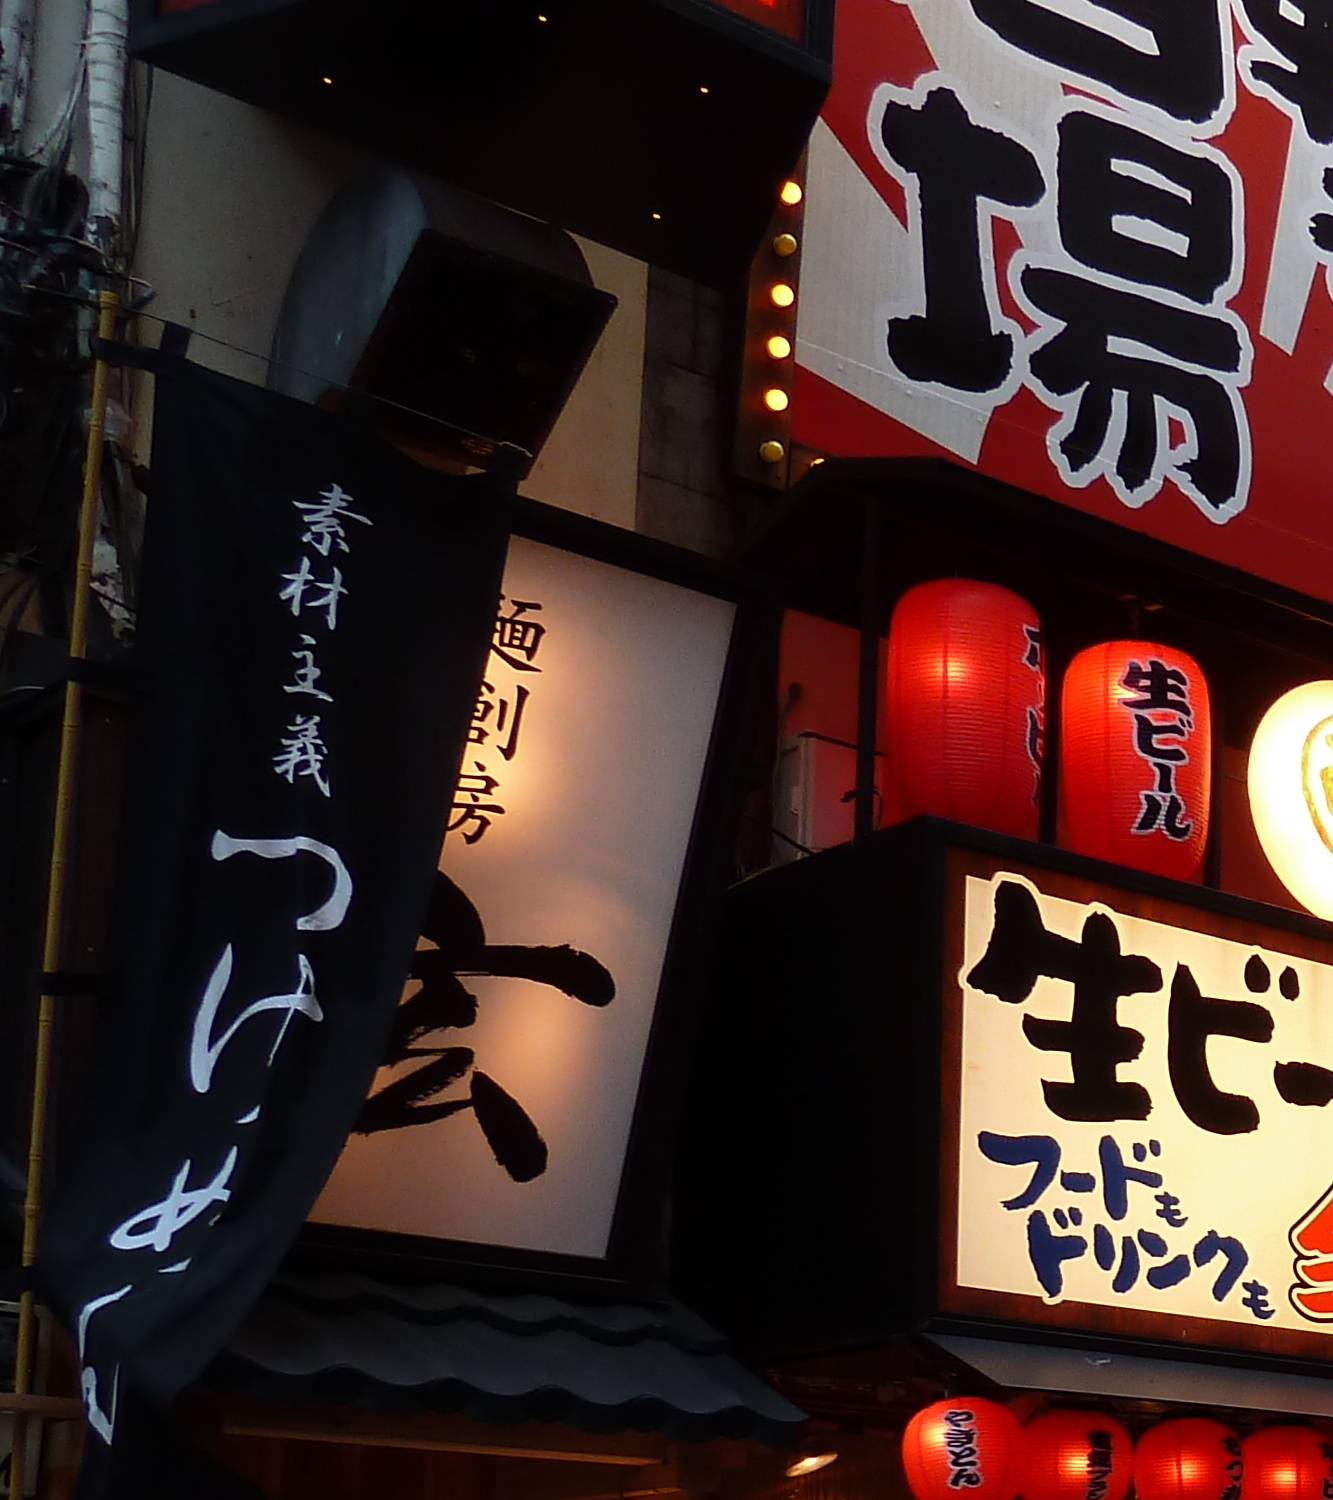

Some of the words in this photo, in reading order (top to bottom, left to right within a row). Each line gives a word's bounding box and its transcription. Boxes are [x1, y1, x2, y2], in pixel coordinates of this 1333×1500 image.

[273, 484, 373, 797] 素材主義
[1123, 661, 1193, 838] 生ビール
[980, 1130, 1188, 1228] フードも
[1029, 1208, 1274, 1320] ドリンクも
